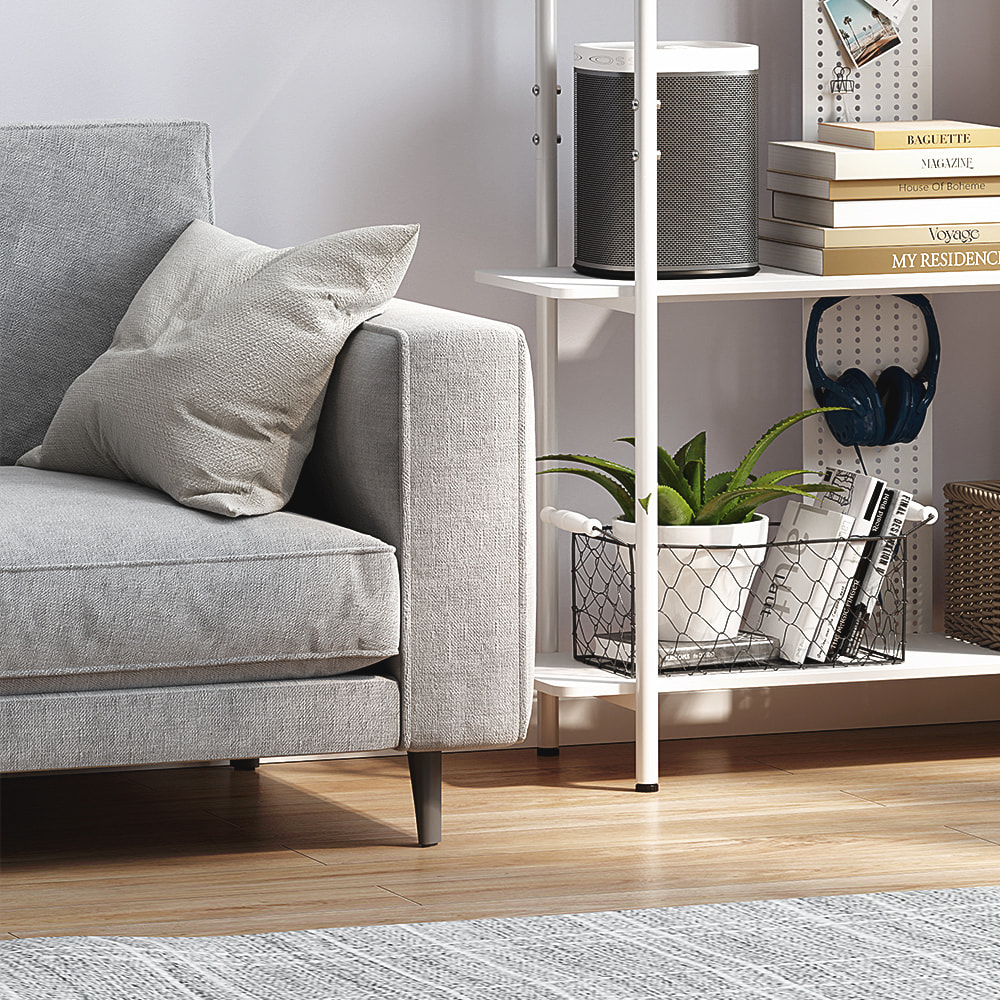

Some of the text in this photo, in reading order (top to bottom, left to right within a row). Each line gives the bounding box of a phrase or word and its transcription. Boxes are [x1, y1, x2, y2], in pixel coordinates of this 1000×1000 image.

[907, 133, 971, 145] BAGUETTE
[921, 157, 974, 170] MAGAZINE
[898, 181, 986, 192] House Of Boheme
[928, 226, 980, 243] Voyage
[892, 253, 917, 268] MY
[896, 494, 910, 515] FINAL
